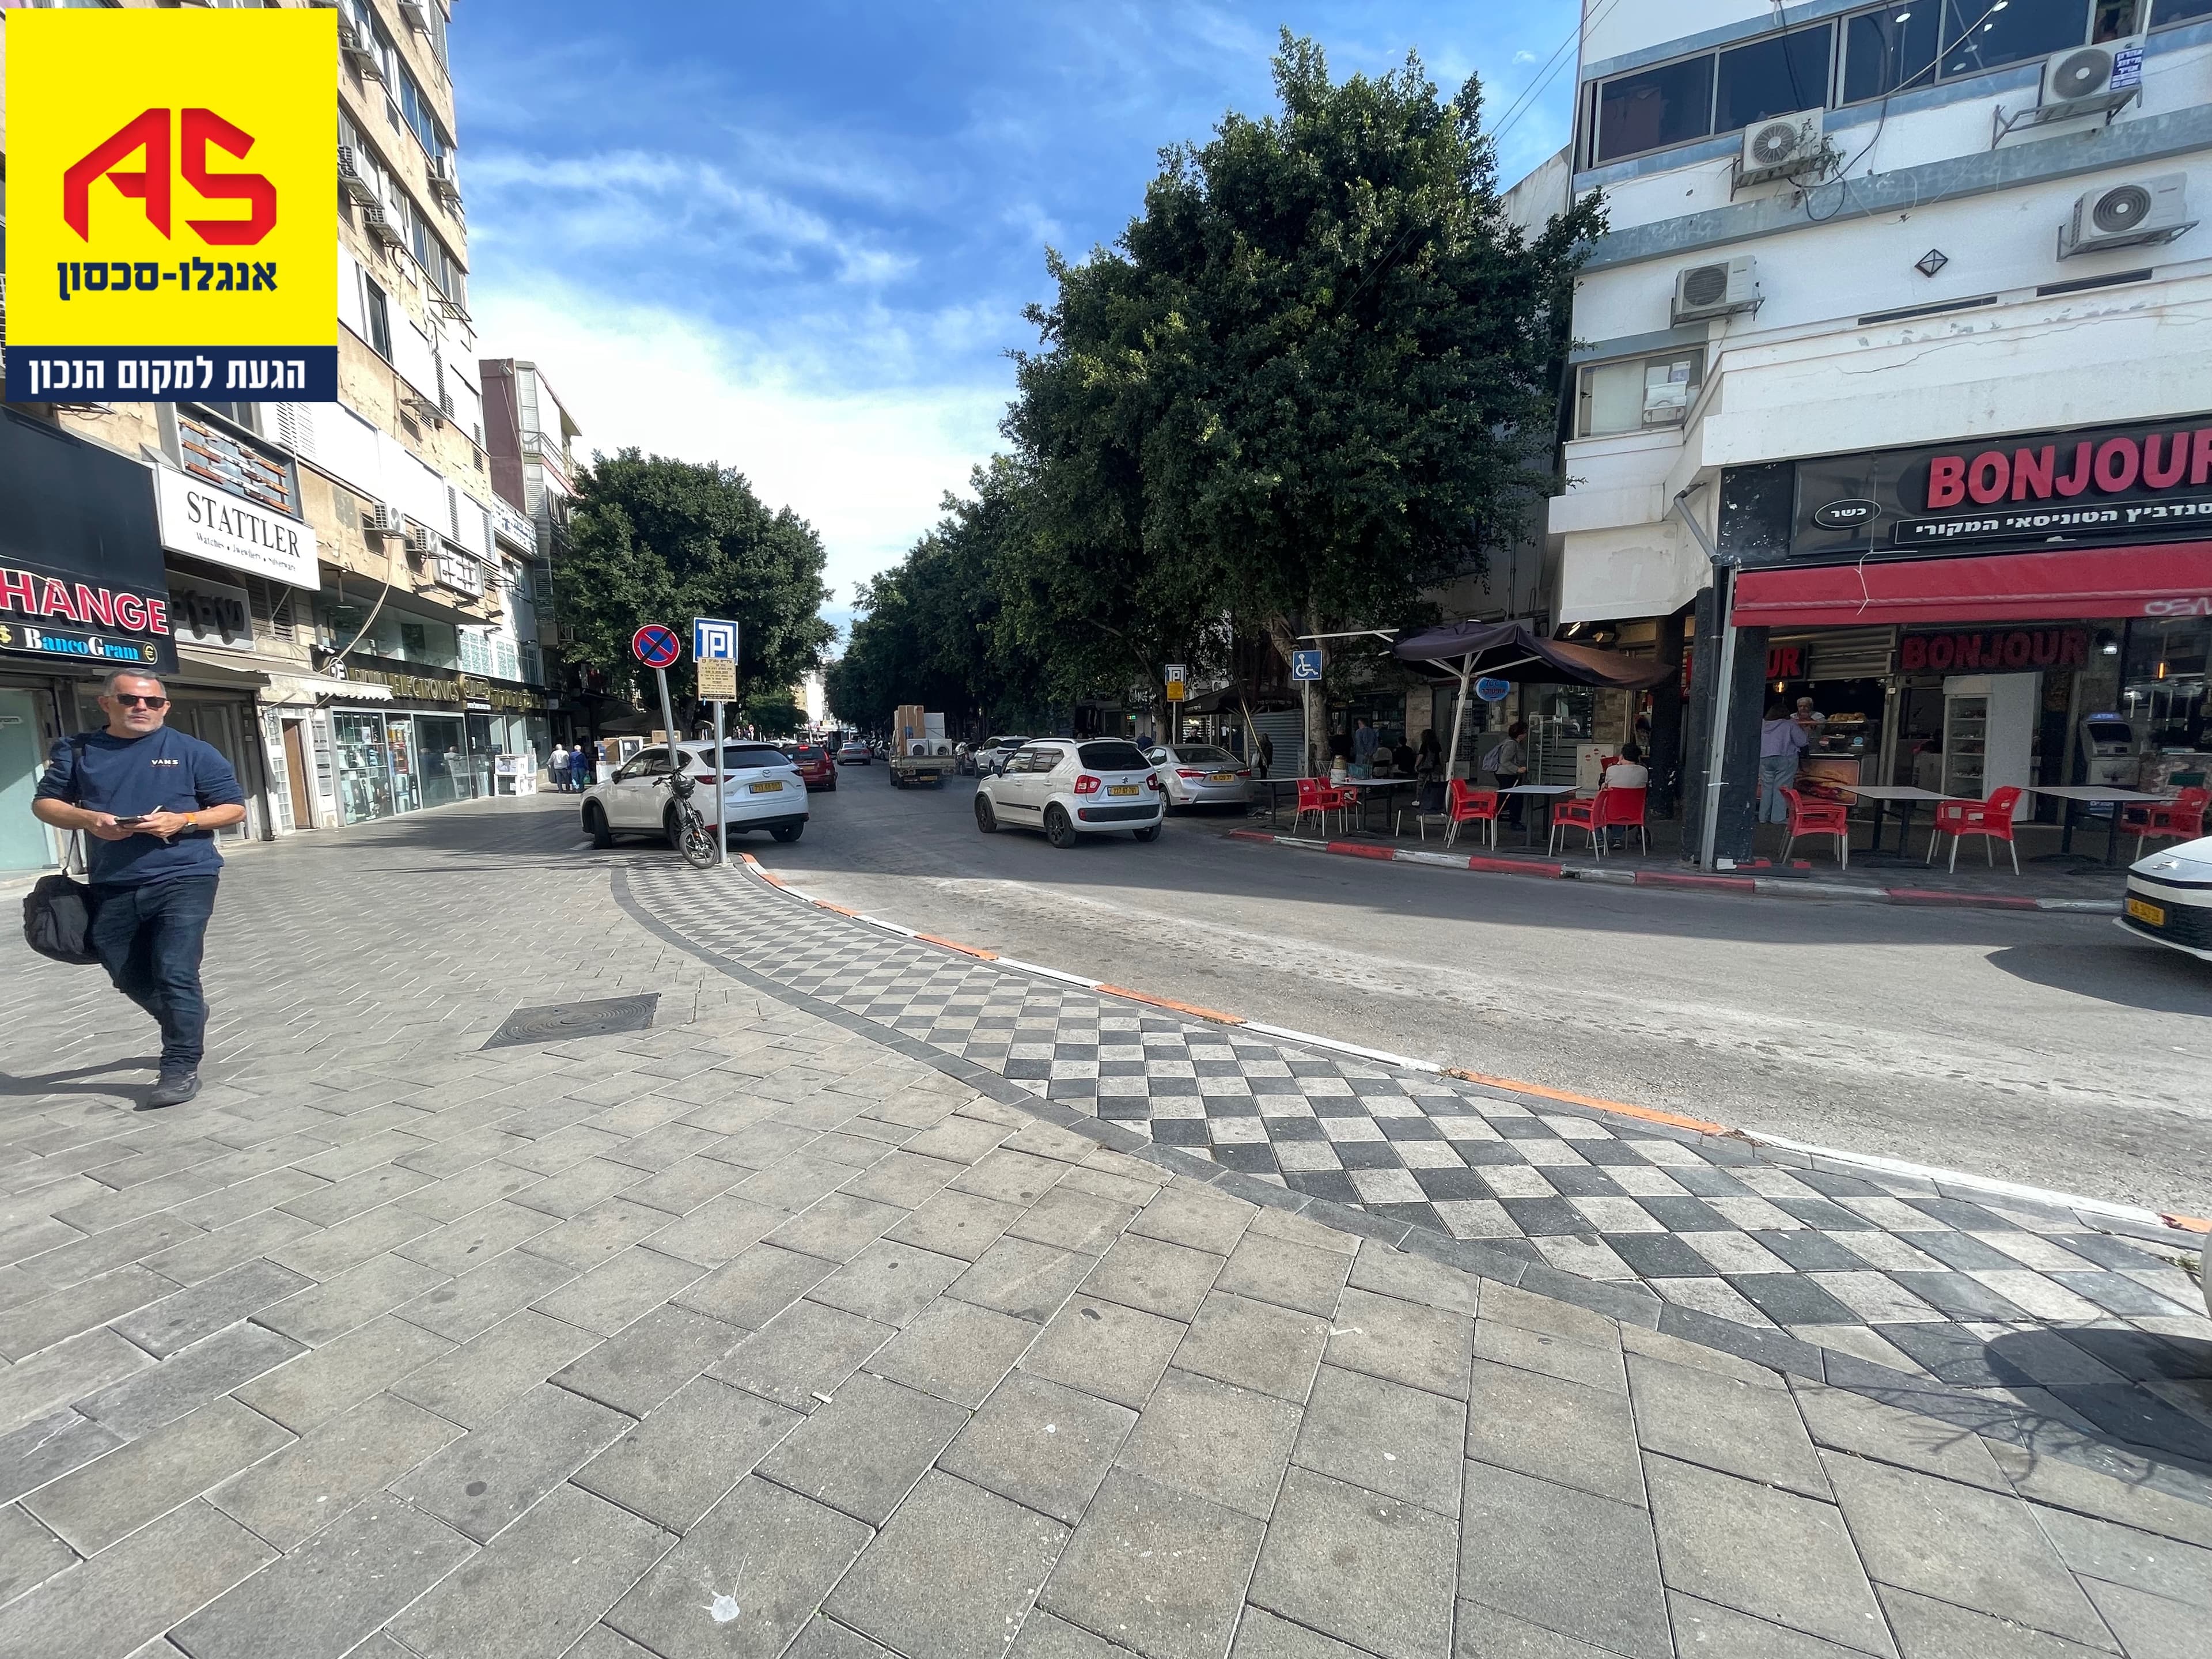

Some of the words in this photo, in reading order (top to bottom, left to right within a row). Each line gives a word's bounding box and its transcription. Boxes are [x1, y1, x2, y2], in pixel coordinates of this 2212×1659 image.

[187, 491, 300, 558] STATTLER
[1831, 508, 1866, 517] כשר
[2006, 510, 2118, 529] הטוניסאי
[2125, 503, 2212, 522] סנדביץ
[1915, 520, 1999, 537] המקורי
[0, 567, 169, 635] HANGE
[23, 627, 139, 660] BancoGram
[1902, 628, 2086, 671] BONJOUR
